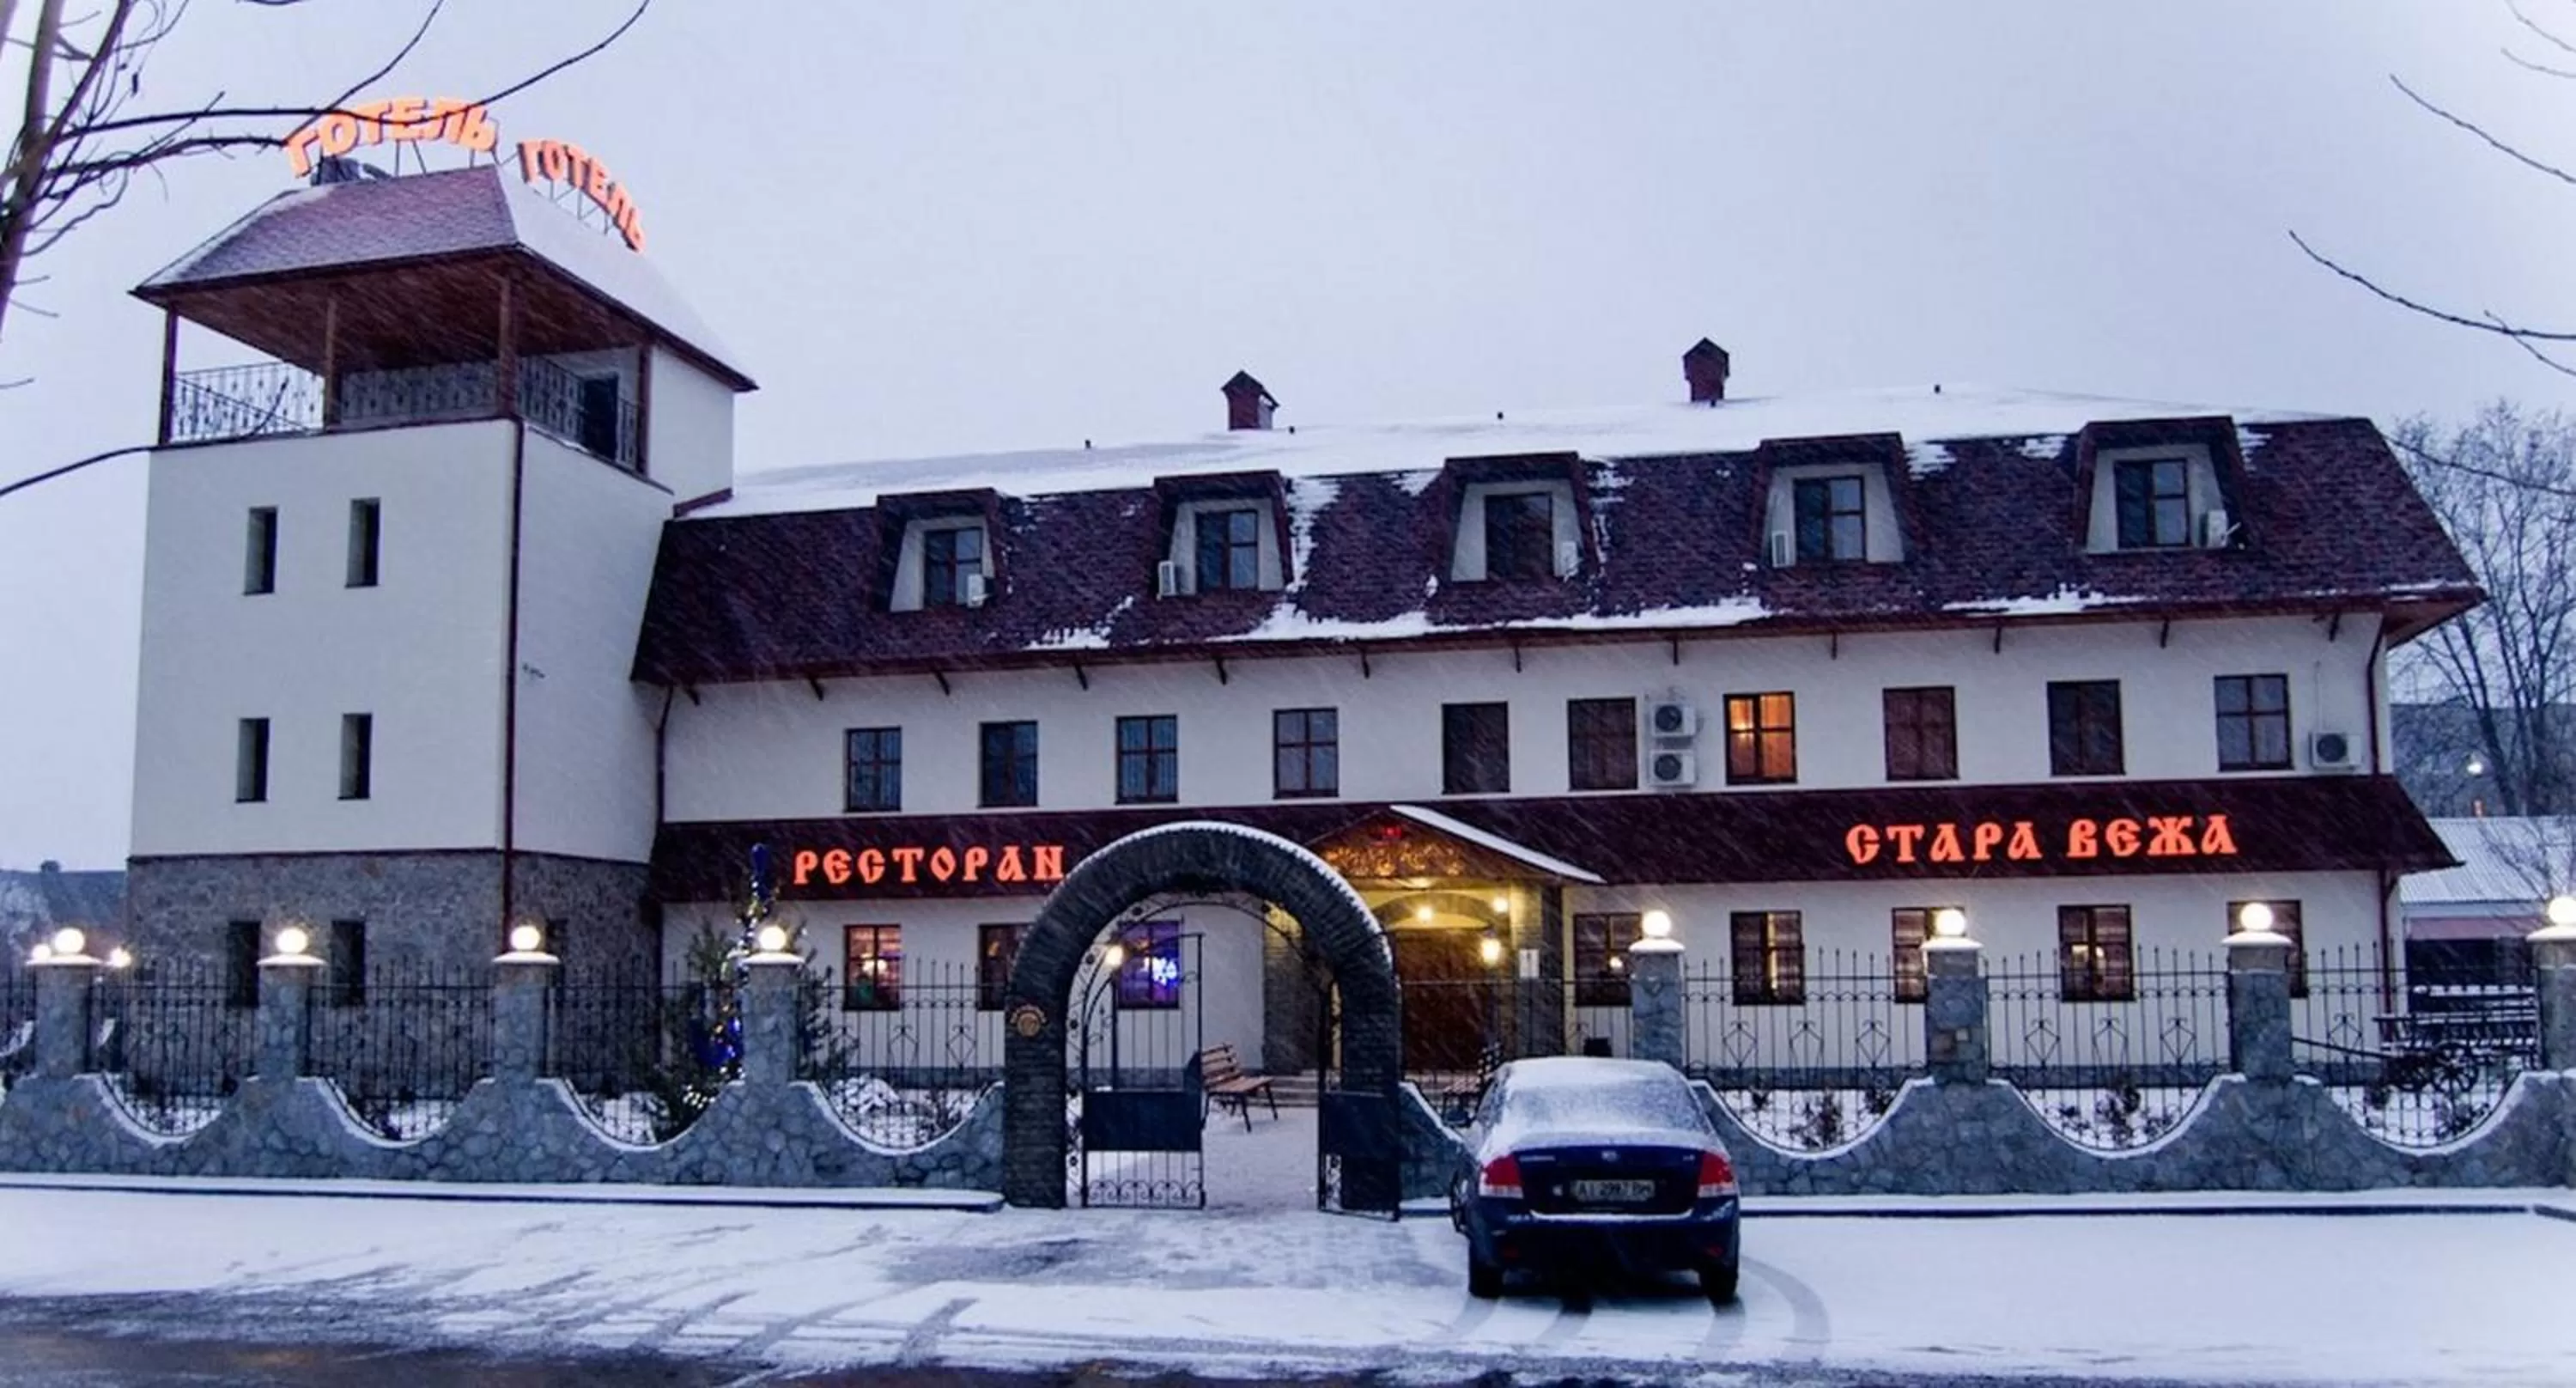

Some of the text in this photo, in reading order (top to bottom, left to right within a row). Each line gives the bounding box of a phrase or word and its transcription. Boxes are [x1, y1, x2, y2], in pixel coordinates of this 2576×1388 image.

[285, 98, 498, 178] ГОТЕЛЬ
[517, 138, 646, 253] ГОТЕЛЬ
[794, 845, 1064, 885] РЕСТОРАН
[1845, 814, 2238, 864] СТАРА ВЕЖА
